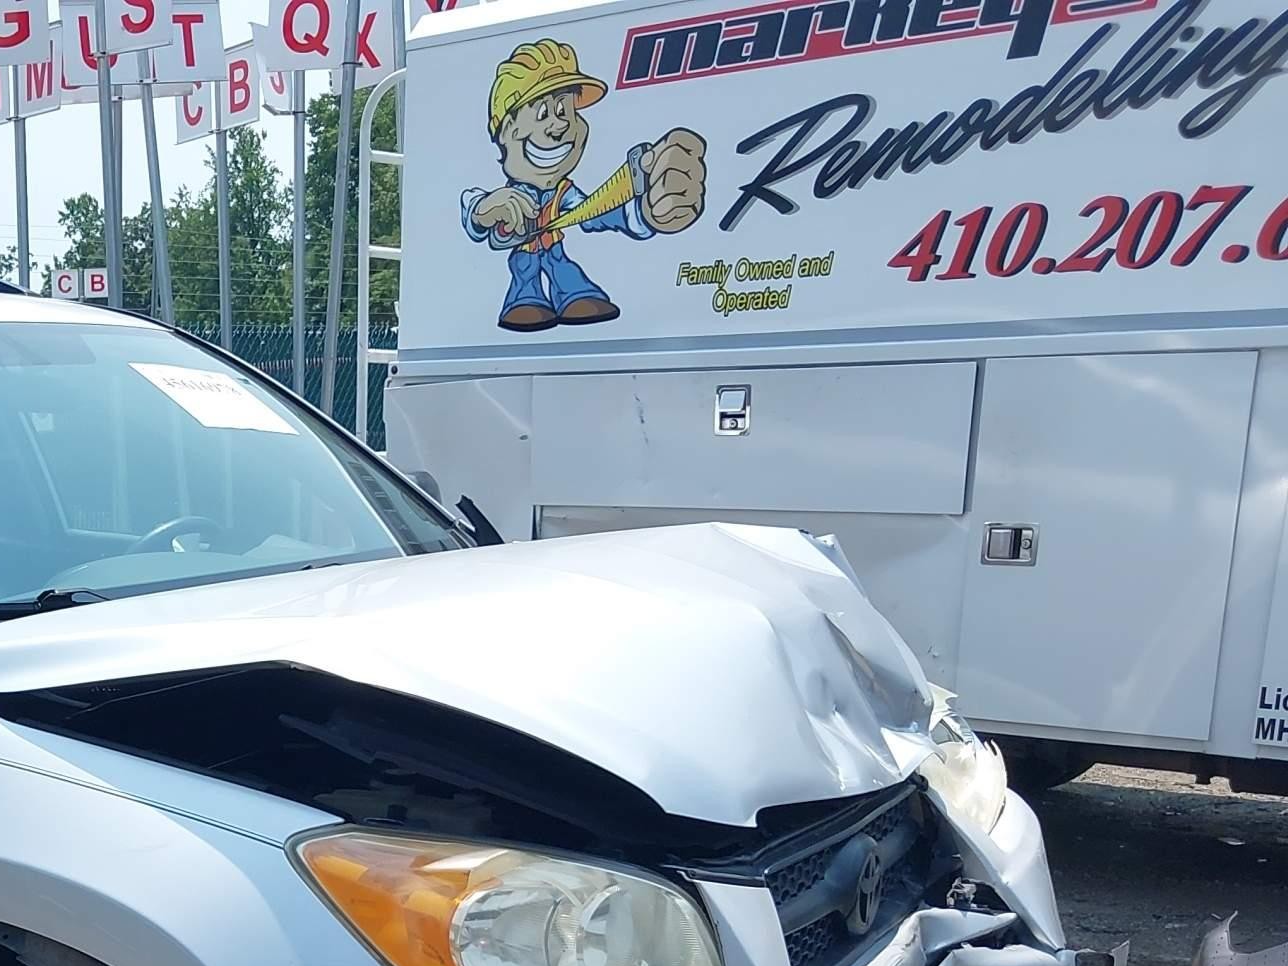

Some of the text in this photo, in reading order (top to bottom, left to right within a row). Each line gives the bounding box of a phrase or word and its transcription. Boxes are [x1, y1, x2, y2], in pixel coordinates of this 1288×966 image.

[121, 0, 155, 34] S
[282, 0, 330, 57] Q
[172, 14, 204, 67] T
[229, 59, 251, 114] B
[718, 0, 1288, 232] Remodeling
[58, 274, 72, 294] C
[90, 274, 105, 292] B
[676, 251, 835, 289] Family Owned and
[712, 284, 792, 317] Operated
